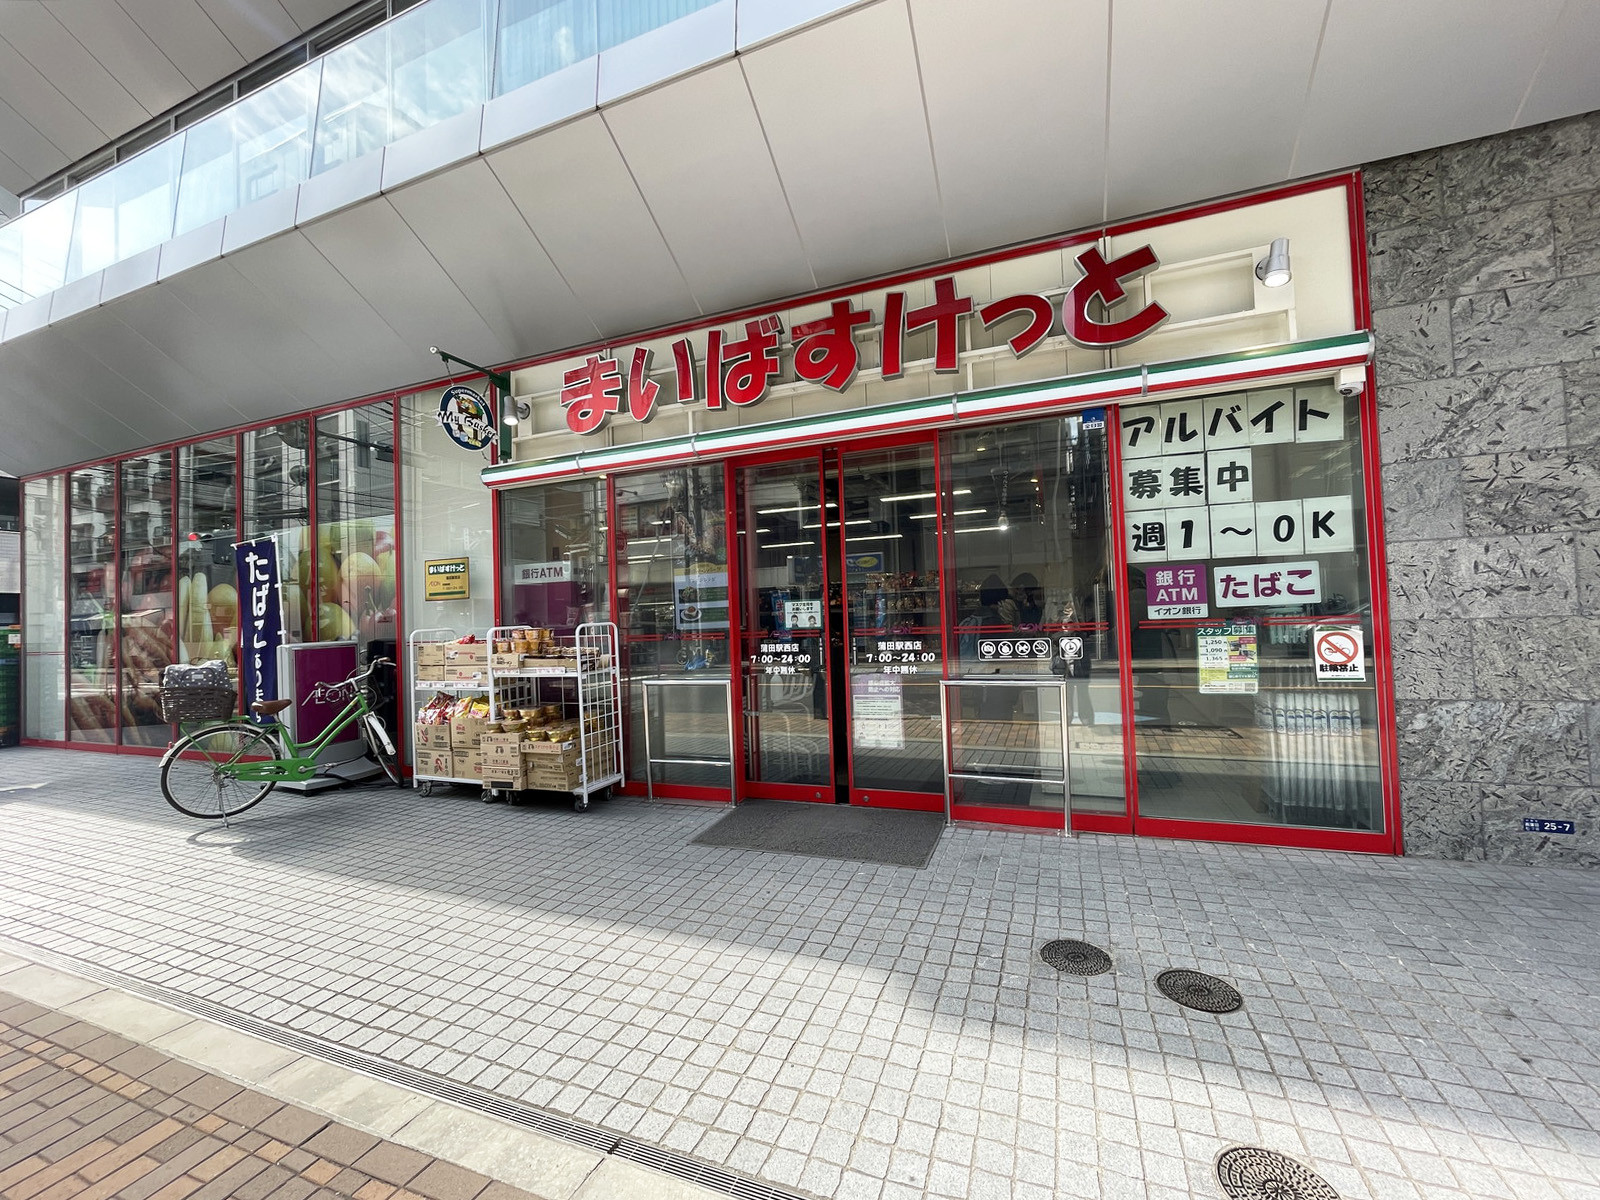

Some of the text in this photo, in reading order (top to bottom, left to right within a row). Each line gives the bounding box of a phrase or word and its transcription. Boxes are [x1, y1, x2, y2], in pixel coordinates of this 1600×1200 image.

[560, 244, 1170, 435] まいばすけっと
[438, 410, 460, 425] My
[1122, 399, 1330, 447] アルバイト
[1129, 461, 1249, 499] 募集中
[1155, 569, 1196, 586] 銀行
[1219, 569, 1315, 599] たばこ
[1156, 588, 1198, 602] ATM
[1154, 606, 1202, 616] イオン銀行
[1544, 822, 1570, 831] 25-7
